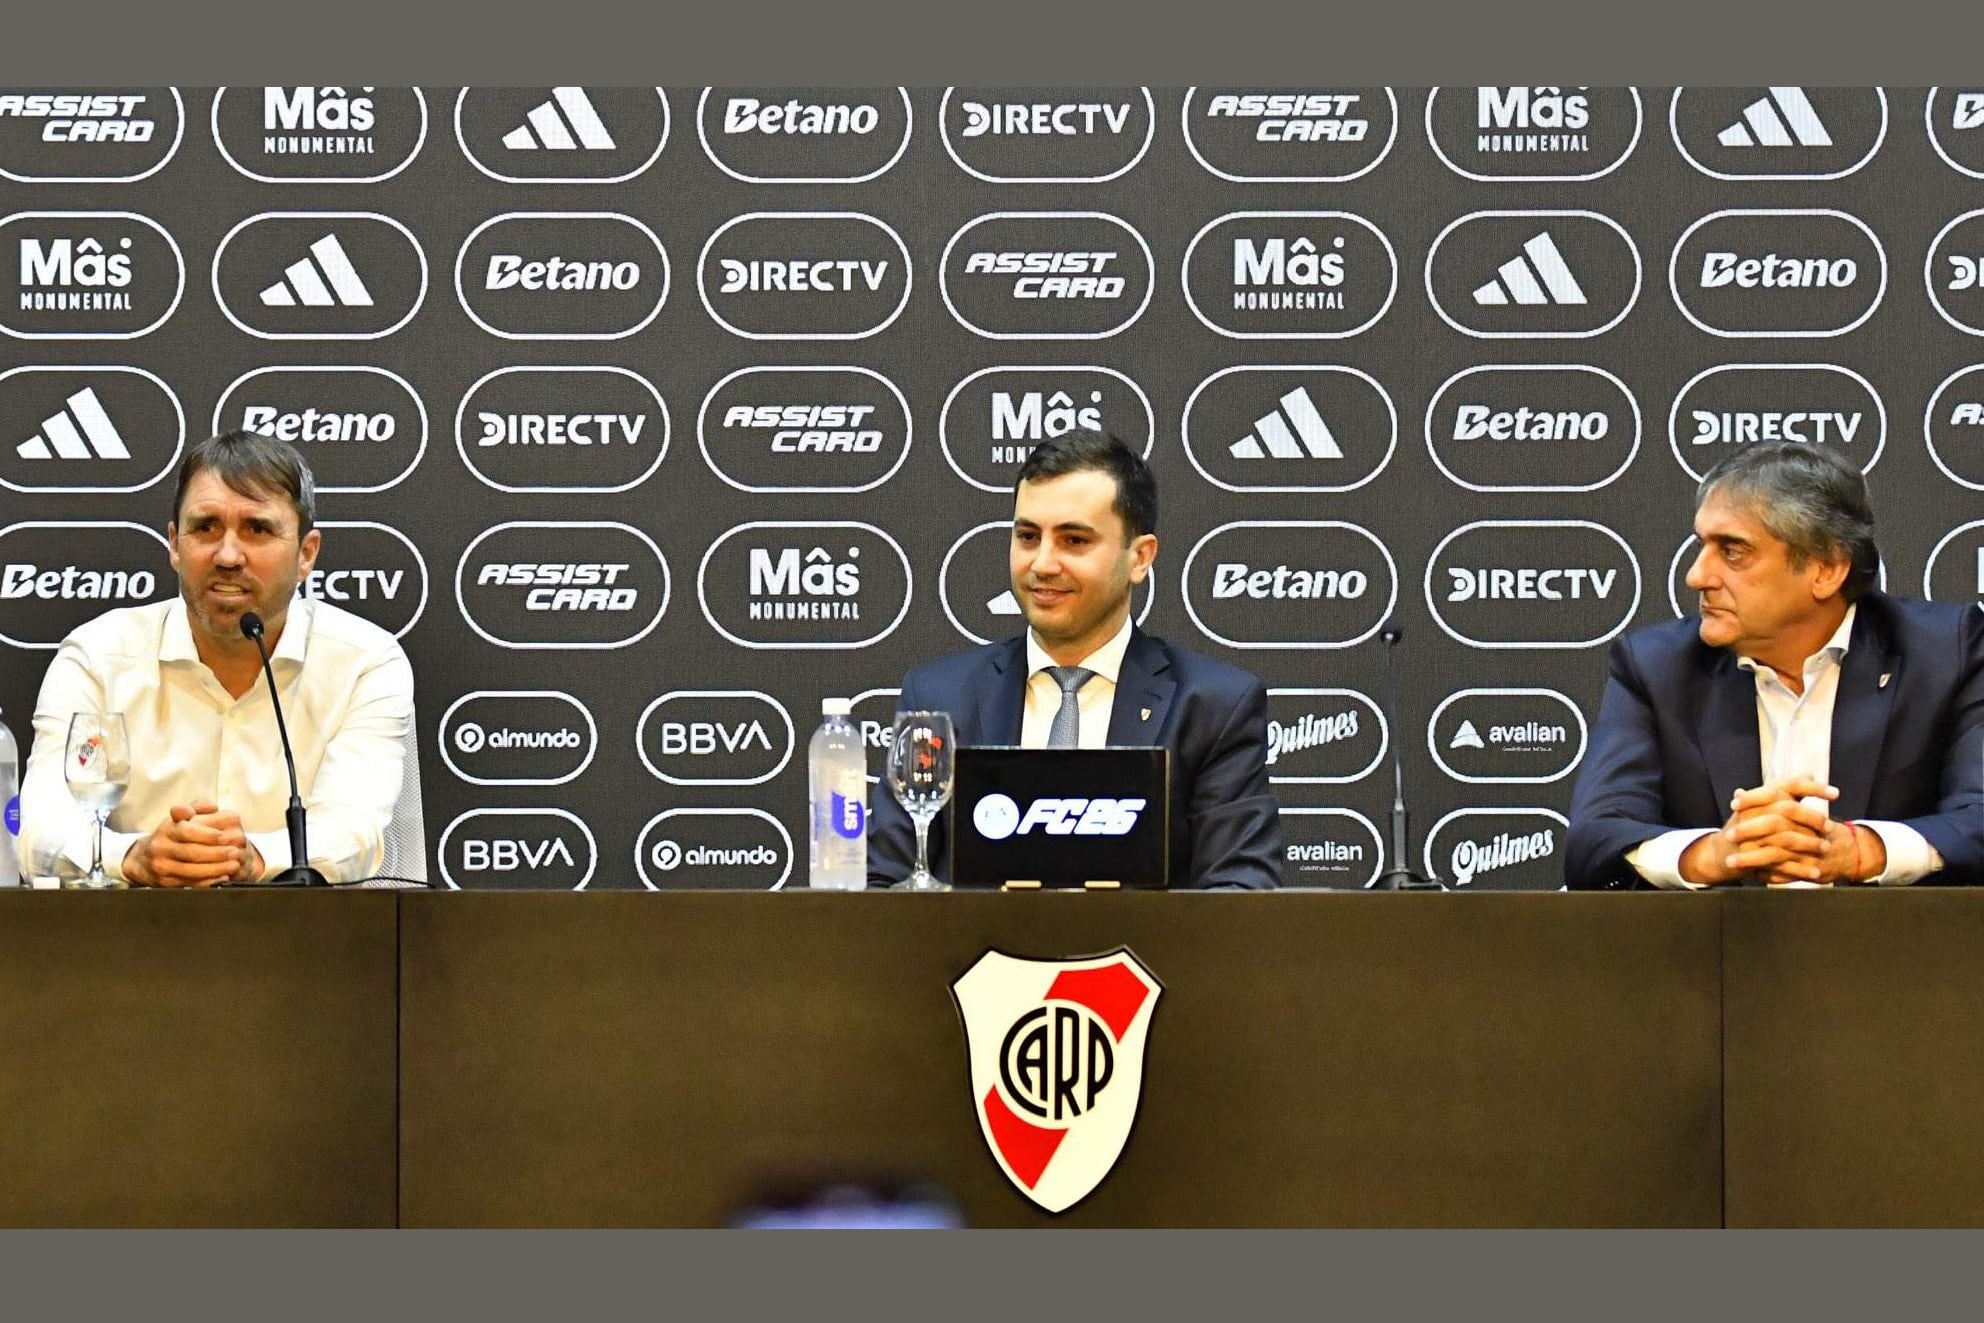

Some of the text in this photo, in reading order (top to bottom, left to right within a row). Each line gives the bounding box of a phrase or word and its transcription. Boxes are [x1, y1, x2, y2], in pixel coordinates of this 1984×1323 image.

[0, 96, 146, 116] ASSIST
[724, 99, 878, 134] Betano
[963, 102, 1130, 136] DIRECTV
[1208, 95, 1360, 116] ASSIST
[42, 120, 154, 141] CARD
[265, 137, 374, 153] MONUMENTAL
[1257, 120, 1368, 141] CARD
[1478, 135, 1588, 152] MONUMENTAL
[21, 238, 131, 286] Mâs
[486, 255, 639, 290] Betano
[721, 259, 888, 292] DIRECTV
[965, 252, 1117, 273] ASSIST
[1234, 237, 1344, 286] Mâs
[1701, 253, 1856, 287] Betano
[21, 293, 131, 310] MONUMENTAL
[1014, 277, 1125, 298] CARD
[1234, 292, 1344, 309] MONUMENTAL
[242, 406, 396, 442] Betano
[479, 413, 645, 446] DIRECTV
[723, 406, 874, 427] ASSIST
[1453, 406, 1608, 440] Betano
[1692, 410, 1862, 445] DIRECTV
[772, 431, 883, 452] CARD
[0, 565, 154, 599] Betano
[305, 569, 404, 600] ECTV
[478, 564, 629, 585] ASSIST
[750, 547, 859, 596] Mâs
[1213, 564, 1367, 598] Betano
[1448, 568, 1616, 601] DIRECTV
[526, 589, 637, 610] CARD
[750, 602, 859, 620] MONUMENTAL
[489, 728, 580, 747] almundo
[662, 720, 772, 754] BBVA
[1489, 722, 1565, 743] avalian
[464, 838, 574, 870] BBVA
[686, 846, 777, 864] almundo
[1287, 841, 1362, 860] avalian
[1452, 830, 1553, 885] Quilmes
[1000, 1006, 1114, 1120] CARP
